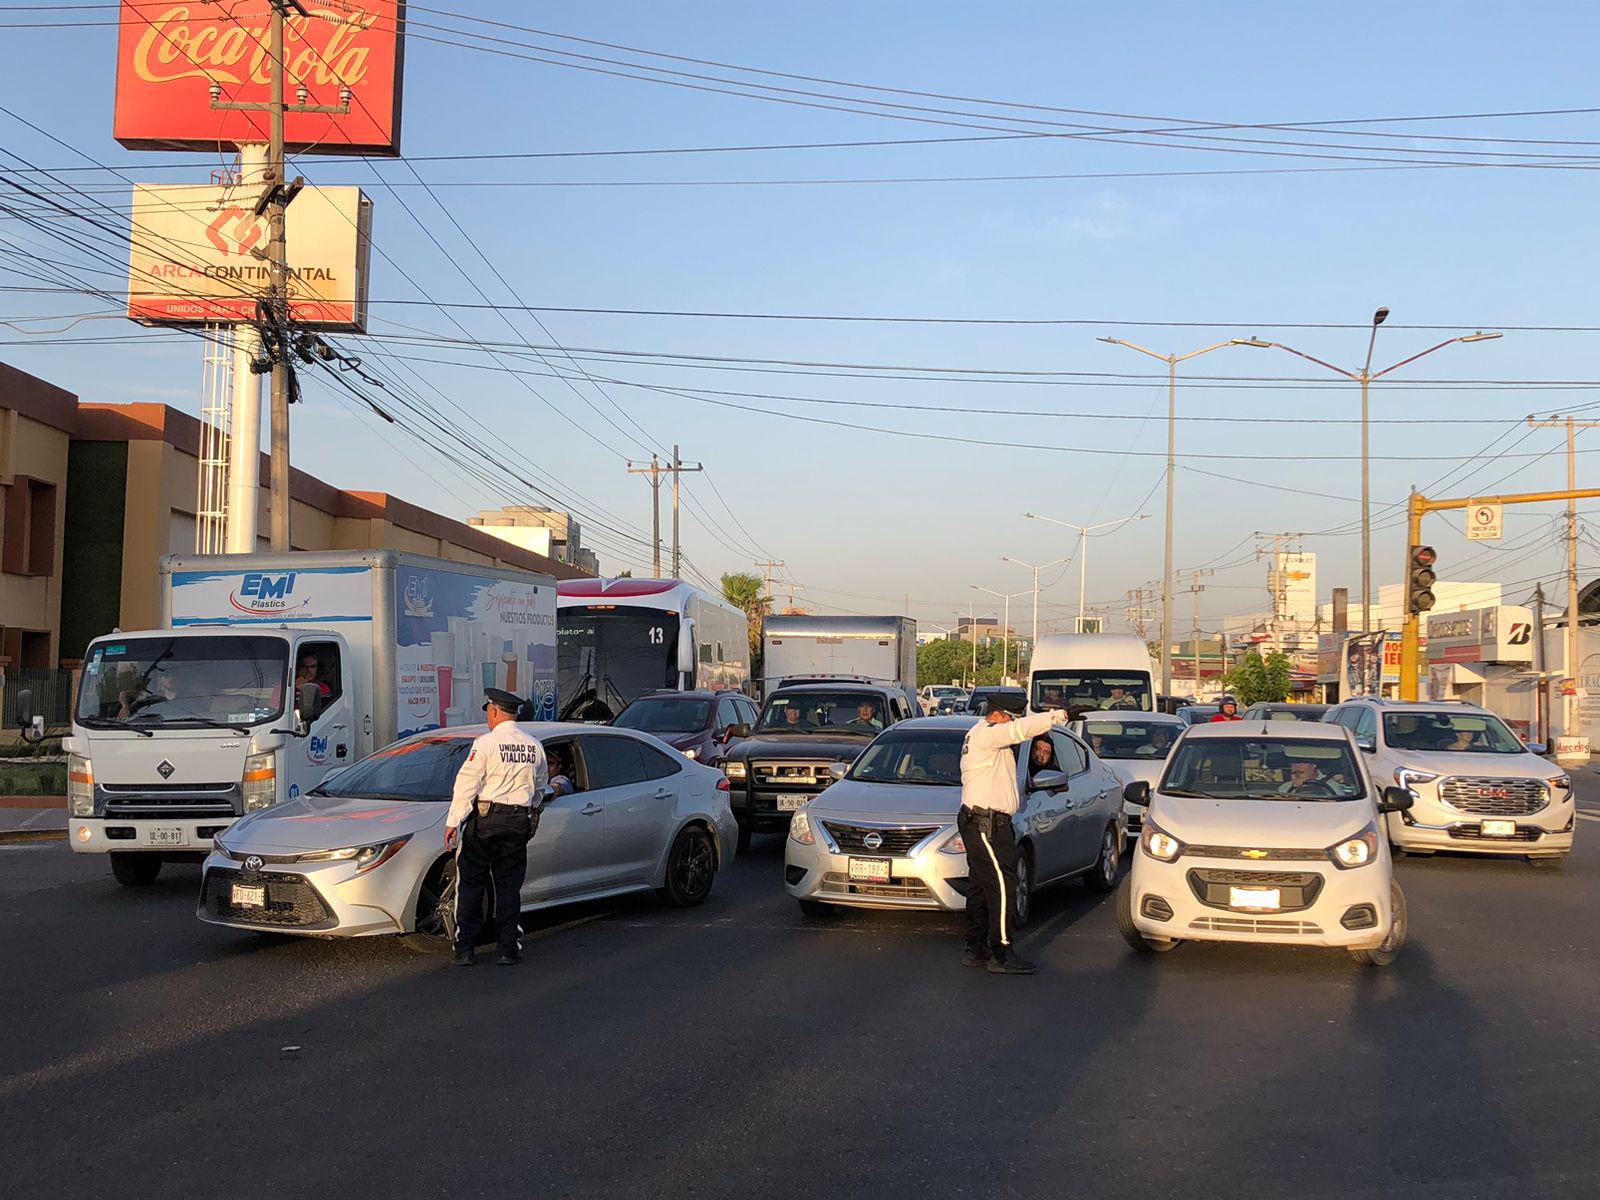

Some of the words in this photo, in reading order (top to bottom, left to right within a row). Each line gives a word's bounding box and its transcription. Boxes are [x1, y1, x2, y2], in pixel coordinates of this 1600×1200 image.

[204, 265, 336, 281] CONTINNTAL
[167, 304, 204, 313] UNIDOS
[209, 306, 235, 314] PARA
[240, 572, 297, 599] EMI
[251, 600, 286, 608] Plastics
[500, 611, 526, 625] NUESTROS
[527, 613, 555, 626] PRODUCTOS
[649, 626, 664, 644] 13
[310, 735, 328, 753] EMI
[499, 744, 525, 752] UNIDAD
[527, 745, 536, 753] DE
[500, 753, 536, 763] VIALIDAD
